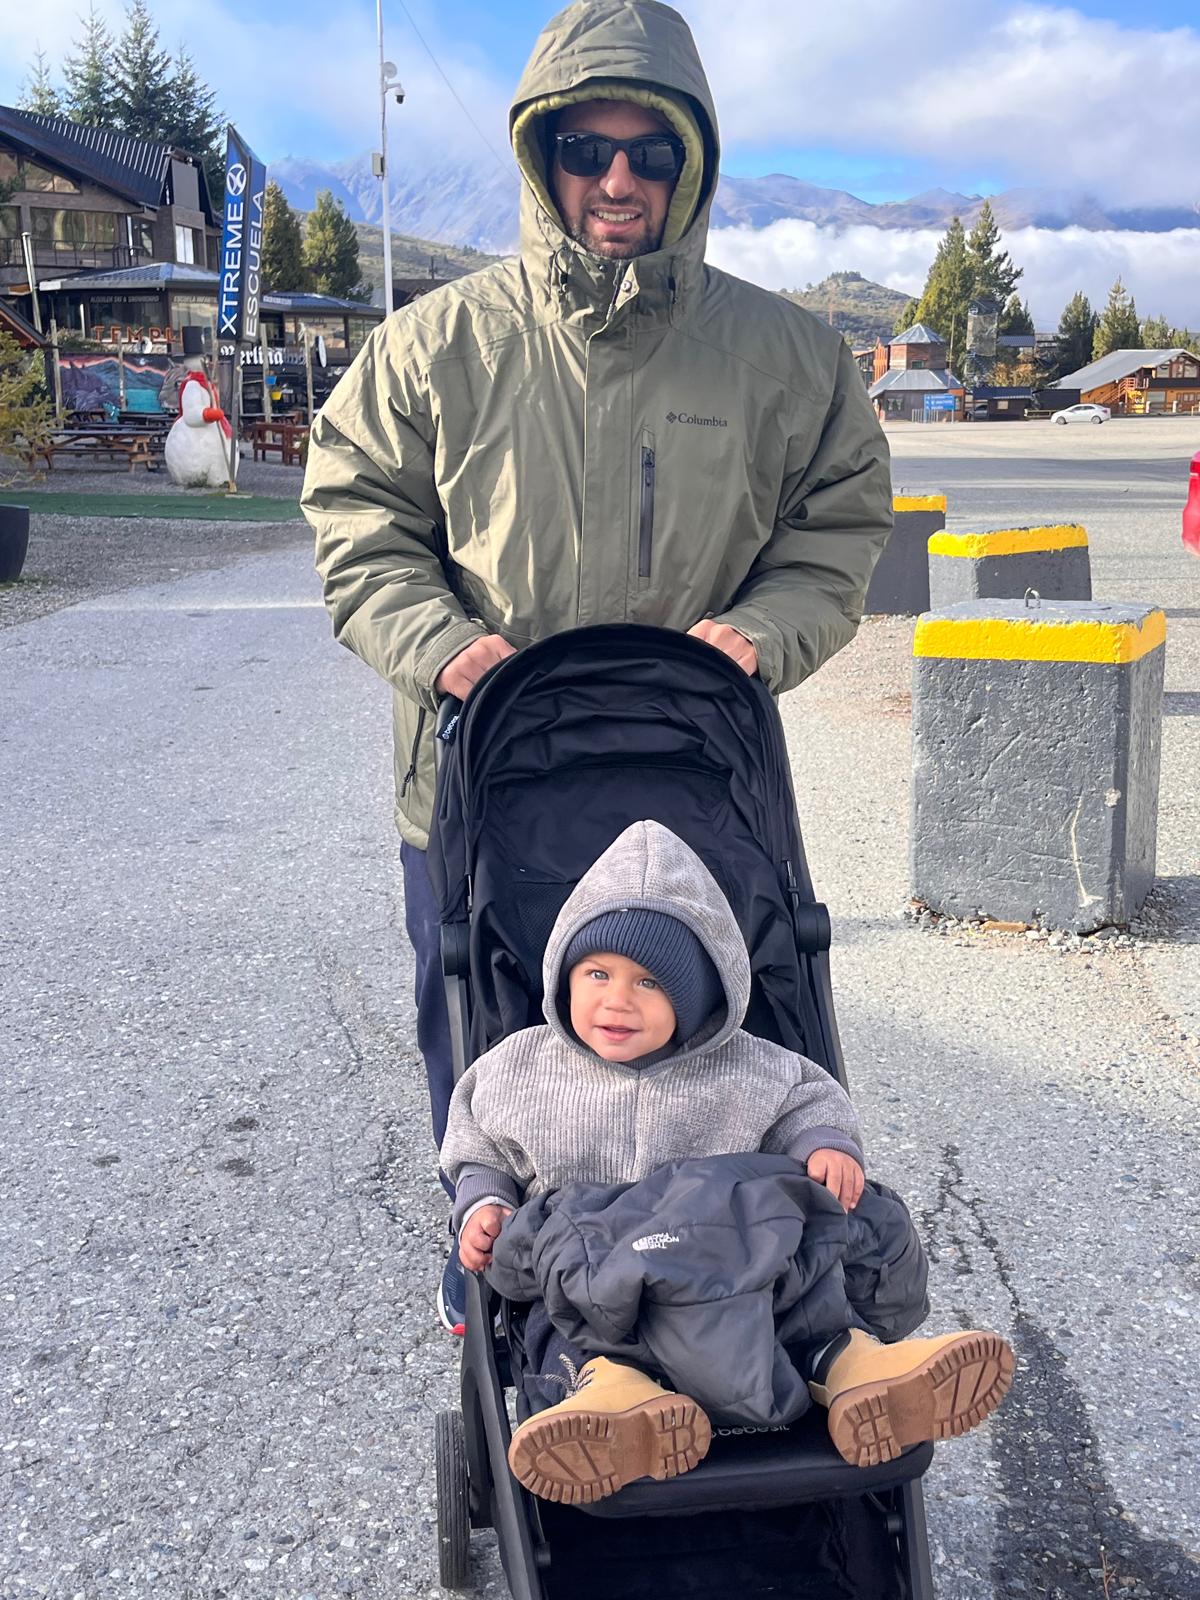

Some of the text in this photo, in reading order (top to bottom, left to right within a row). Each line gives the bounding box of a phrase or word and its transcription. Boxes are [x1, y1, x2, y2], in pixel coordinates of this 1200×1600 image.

[220, 202, 244, 336] XTREME
[245, 191, 264, 337] ESCUELA
[93, 325, 183, 344] TEMPL
[677, 412, 728, 427] Columbia
